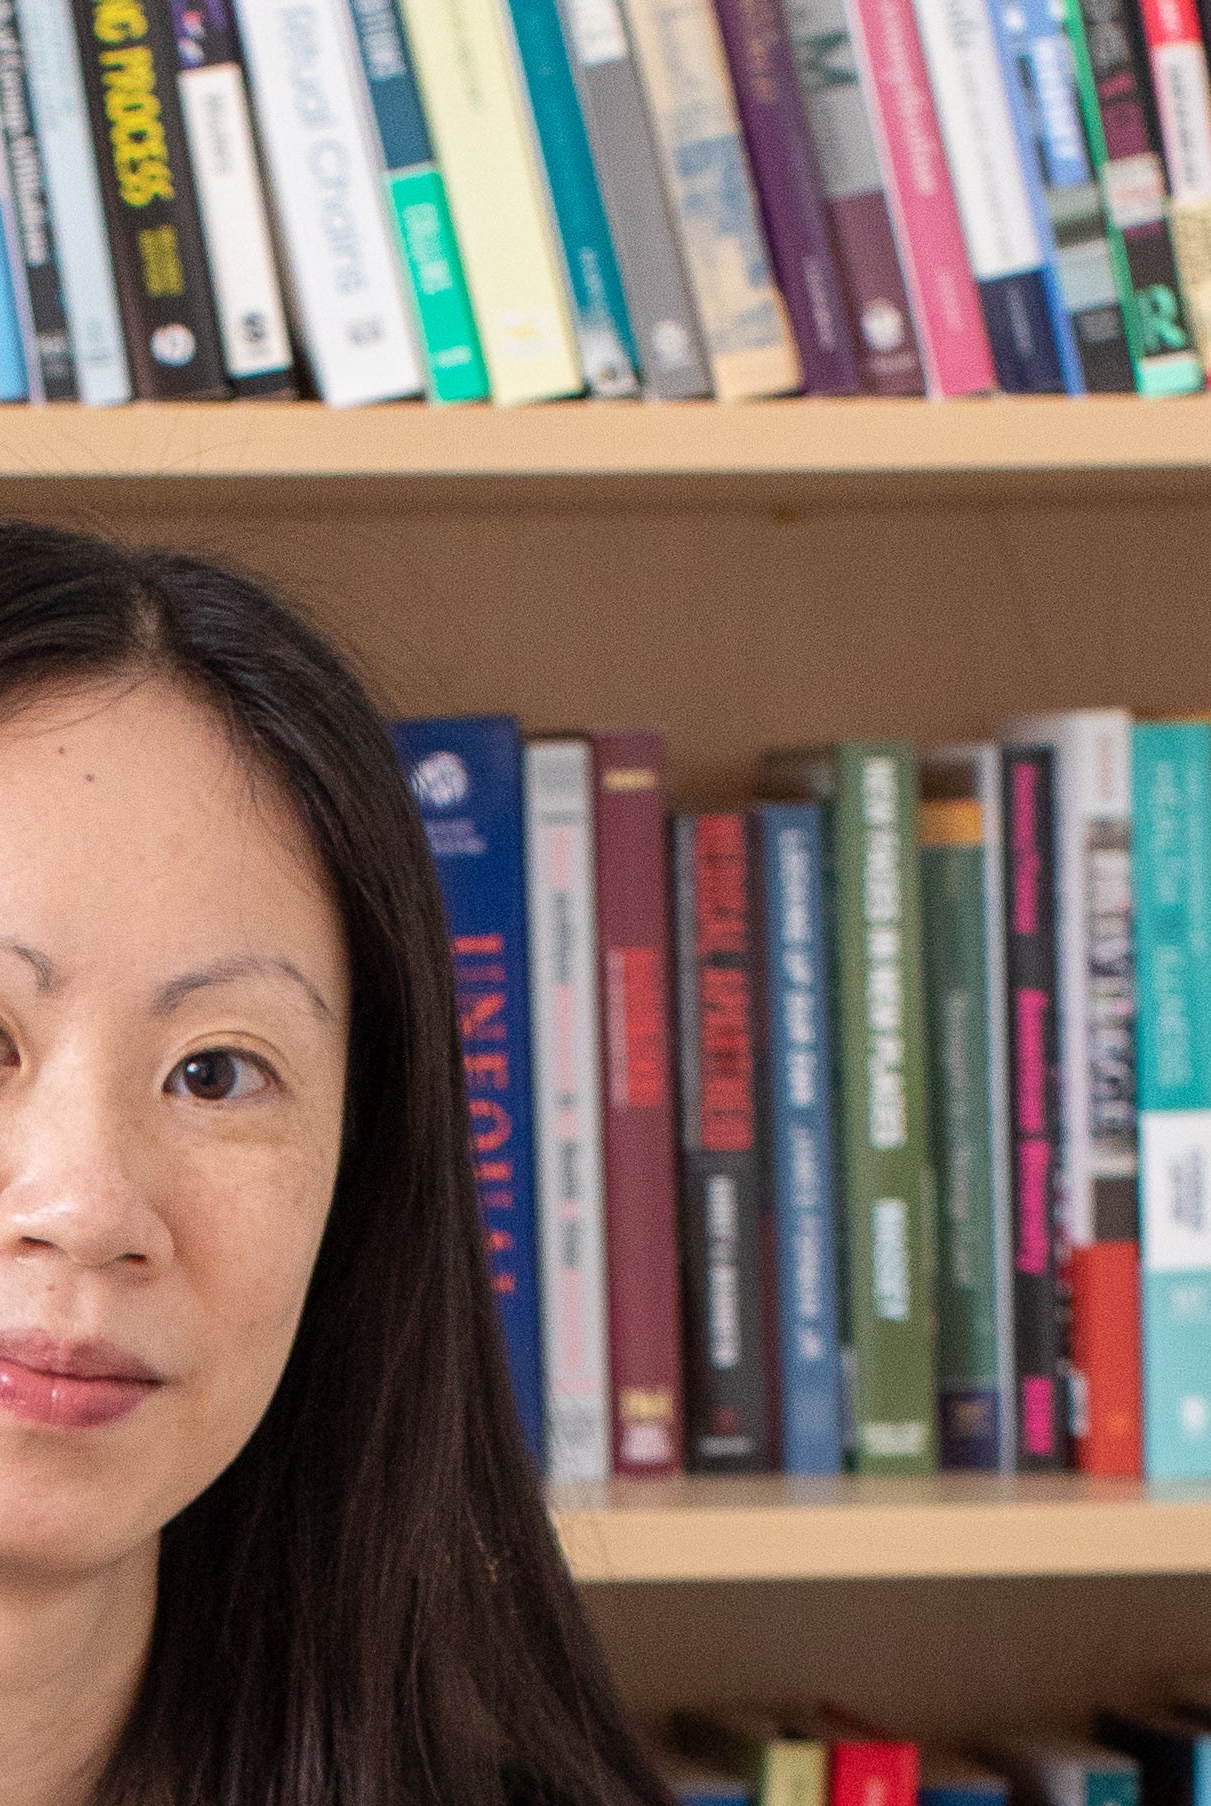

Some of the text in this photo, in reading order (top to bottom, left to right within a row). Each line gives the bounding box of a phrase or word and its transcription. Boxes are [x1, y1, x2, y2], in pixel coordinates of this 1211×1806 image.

[99, 45, 175, 207] PROCESS
[305, 138, 372, 294] Chains
[861, 756, 895, 823] NEW
[1087, 849, 1133, 1136] PRIVILEGE
[867, 1037, 906, 1148] PLACES
